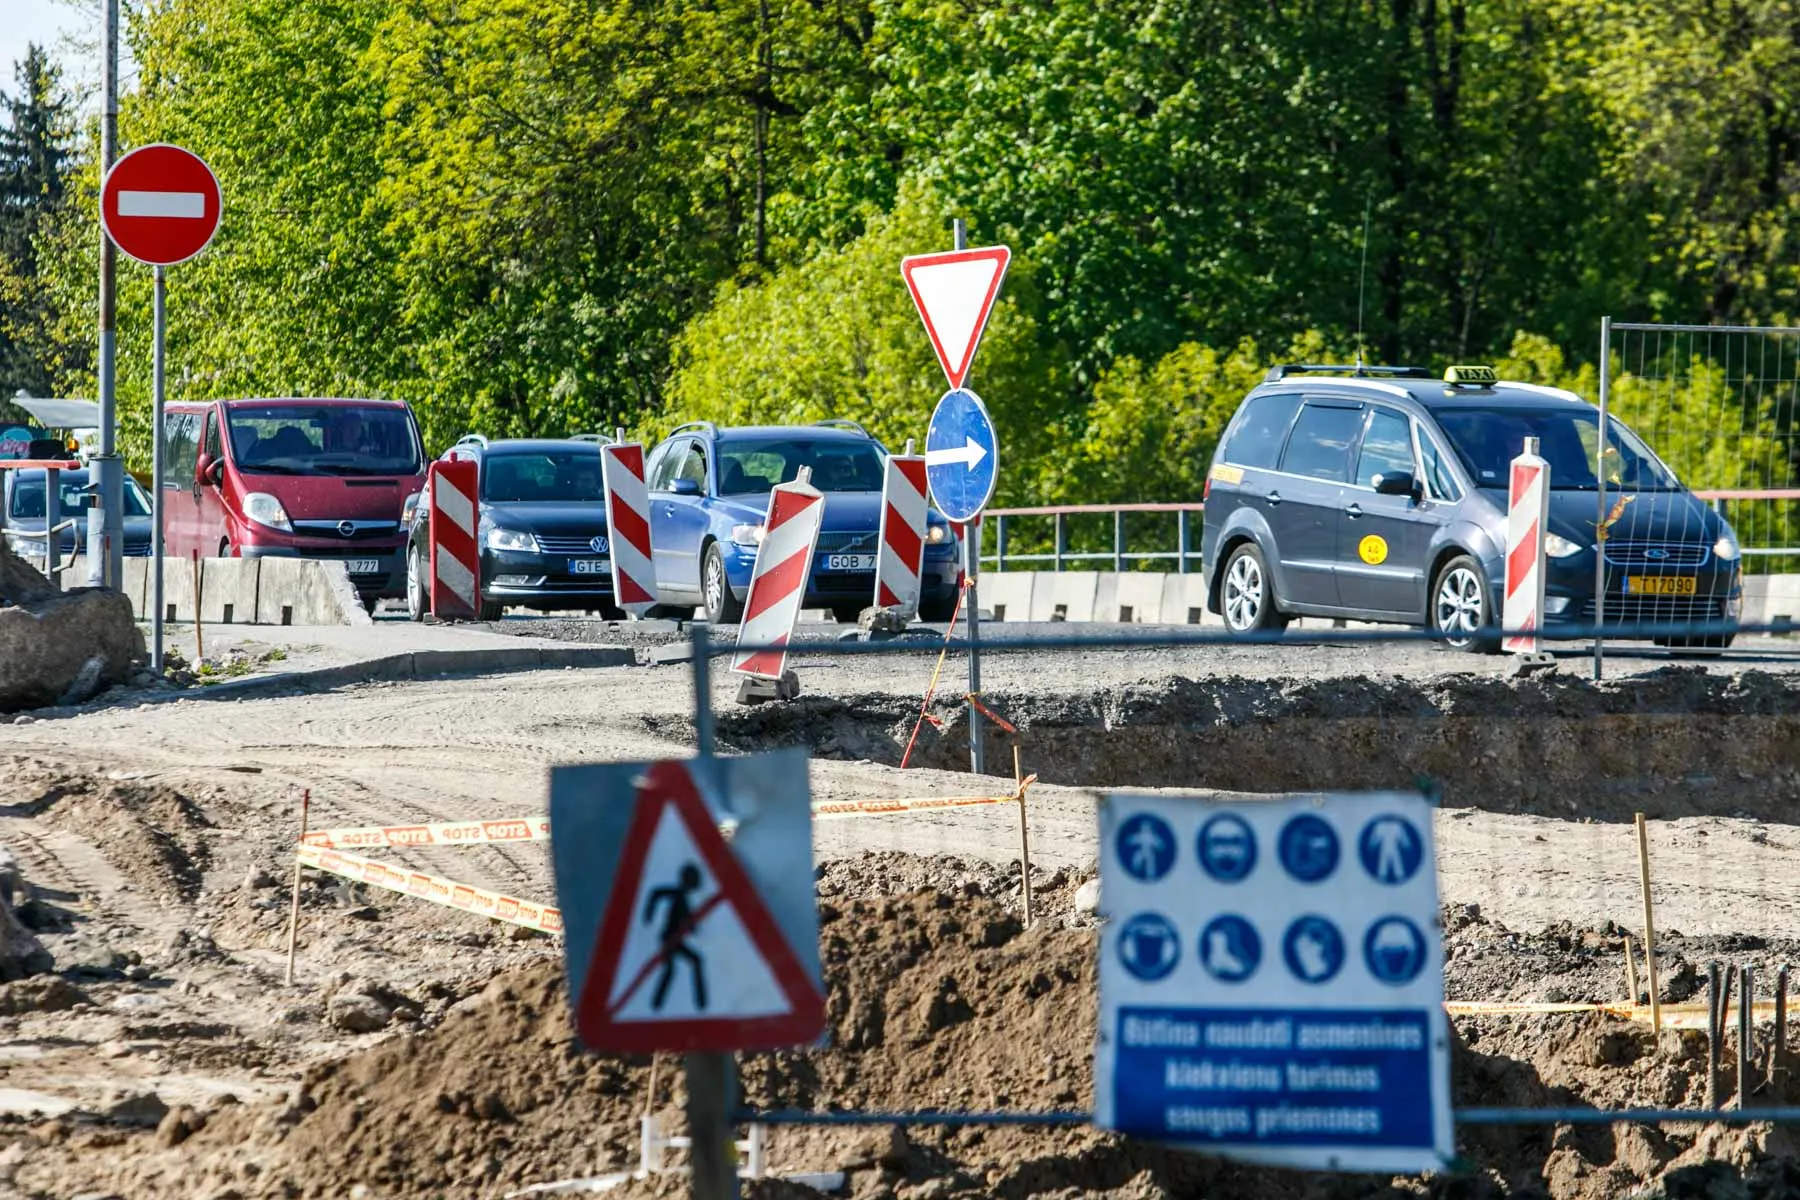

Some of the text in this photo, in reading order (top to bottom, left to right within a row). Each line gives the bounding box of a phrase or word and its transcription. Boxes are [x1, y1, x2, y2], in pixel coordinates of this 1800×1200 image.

[1456, 368, 1494, 380] TAXI
[577, 561, 603, 572] GTE
[831, 556, 859, 568] GOB
